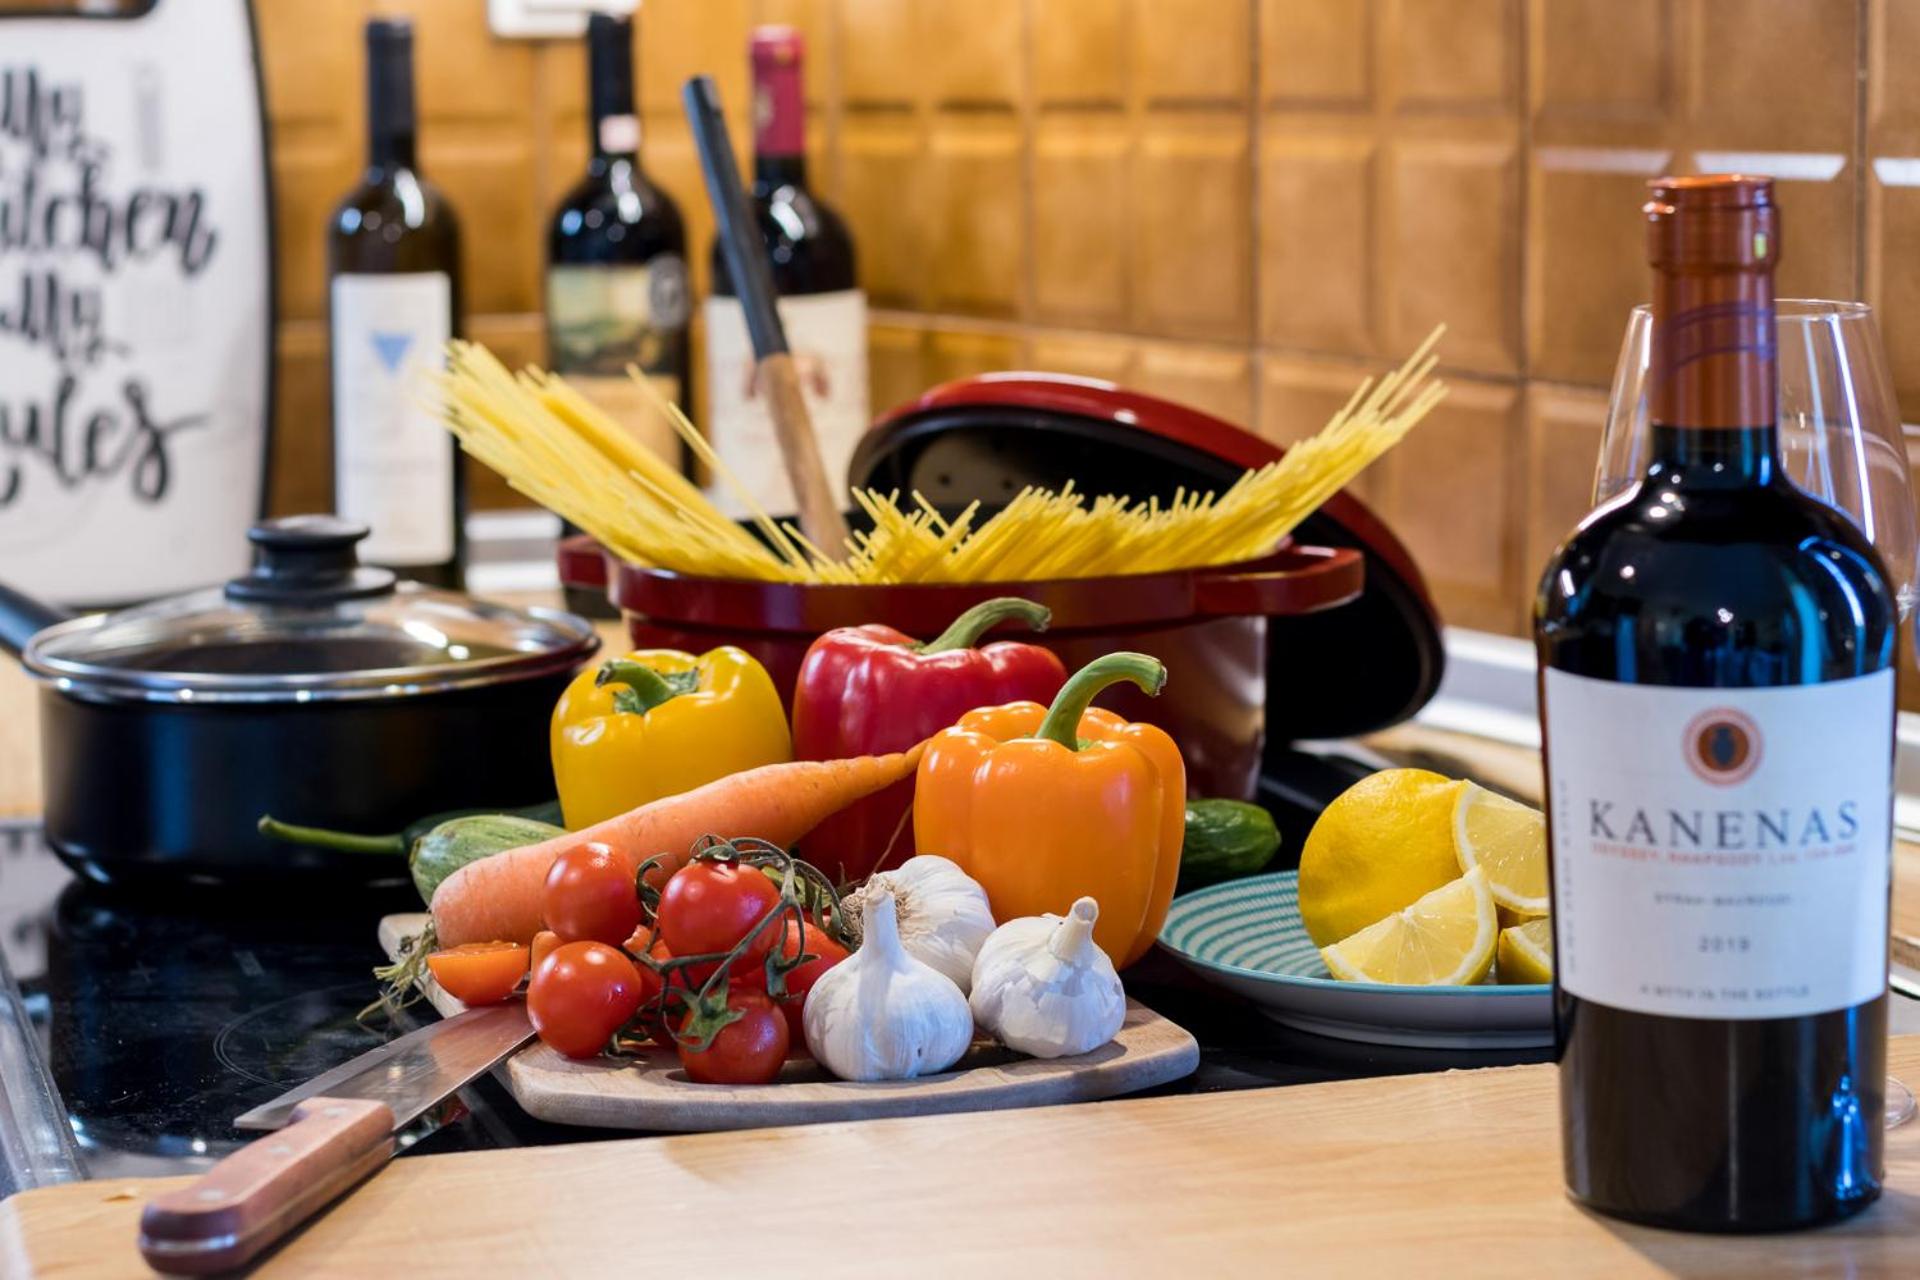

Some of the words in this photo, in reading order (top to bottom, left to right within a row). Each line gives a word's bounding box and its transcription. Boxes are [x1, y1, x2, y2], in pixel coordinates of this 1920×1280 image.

[0, 160, 218, 276] itchen
[0, 373, 208, 505] ules
[1588, 799, 1860, 849] KANENAS
